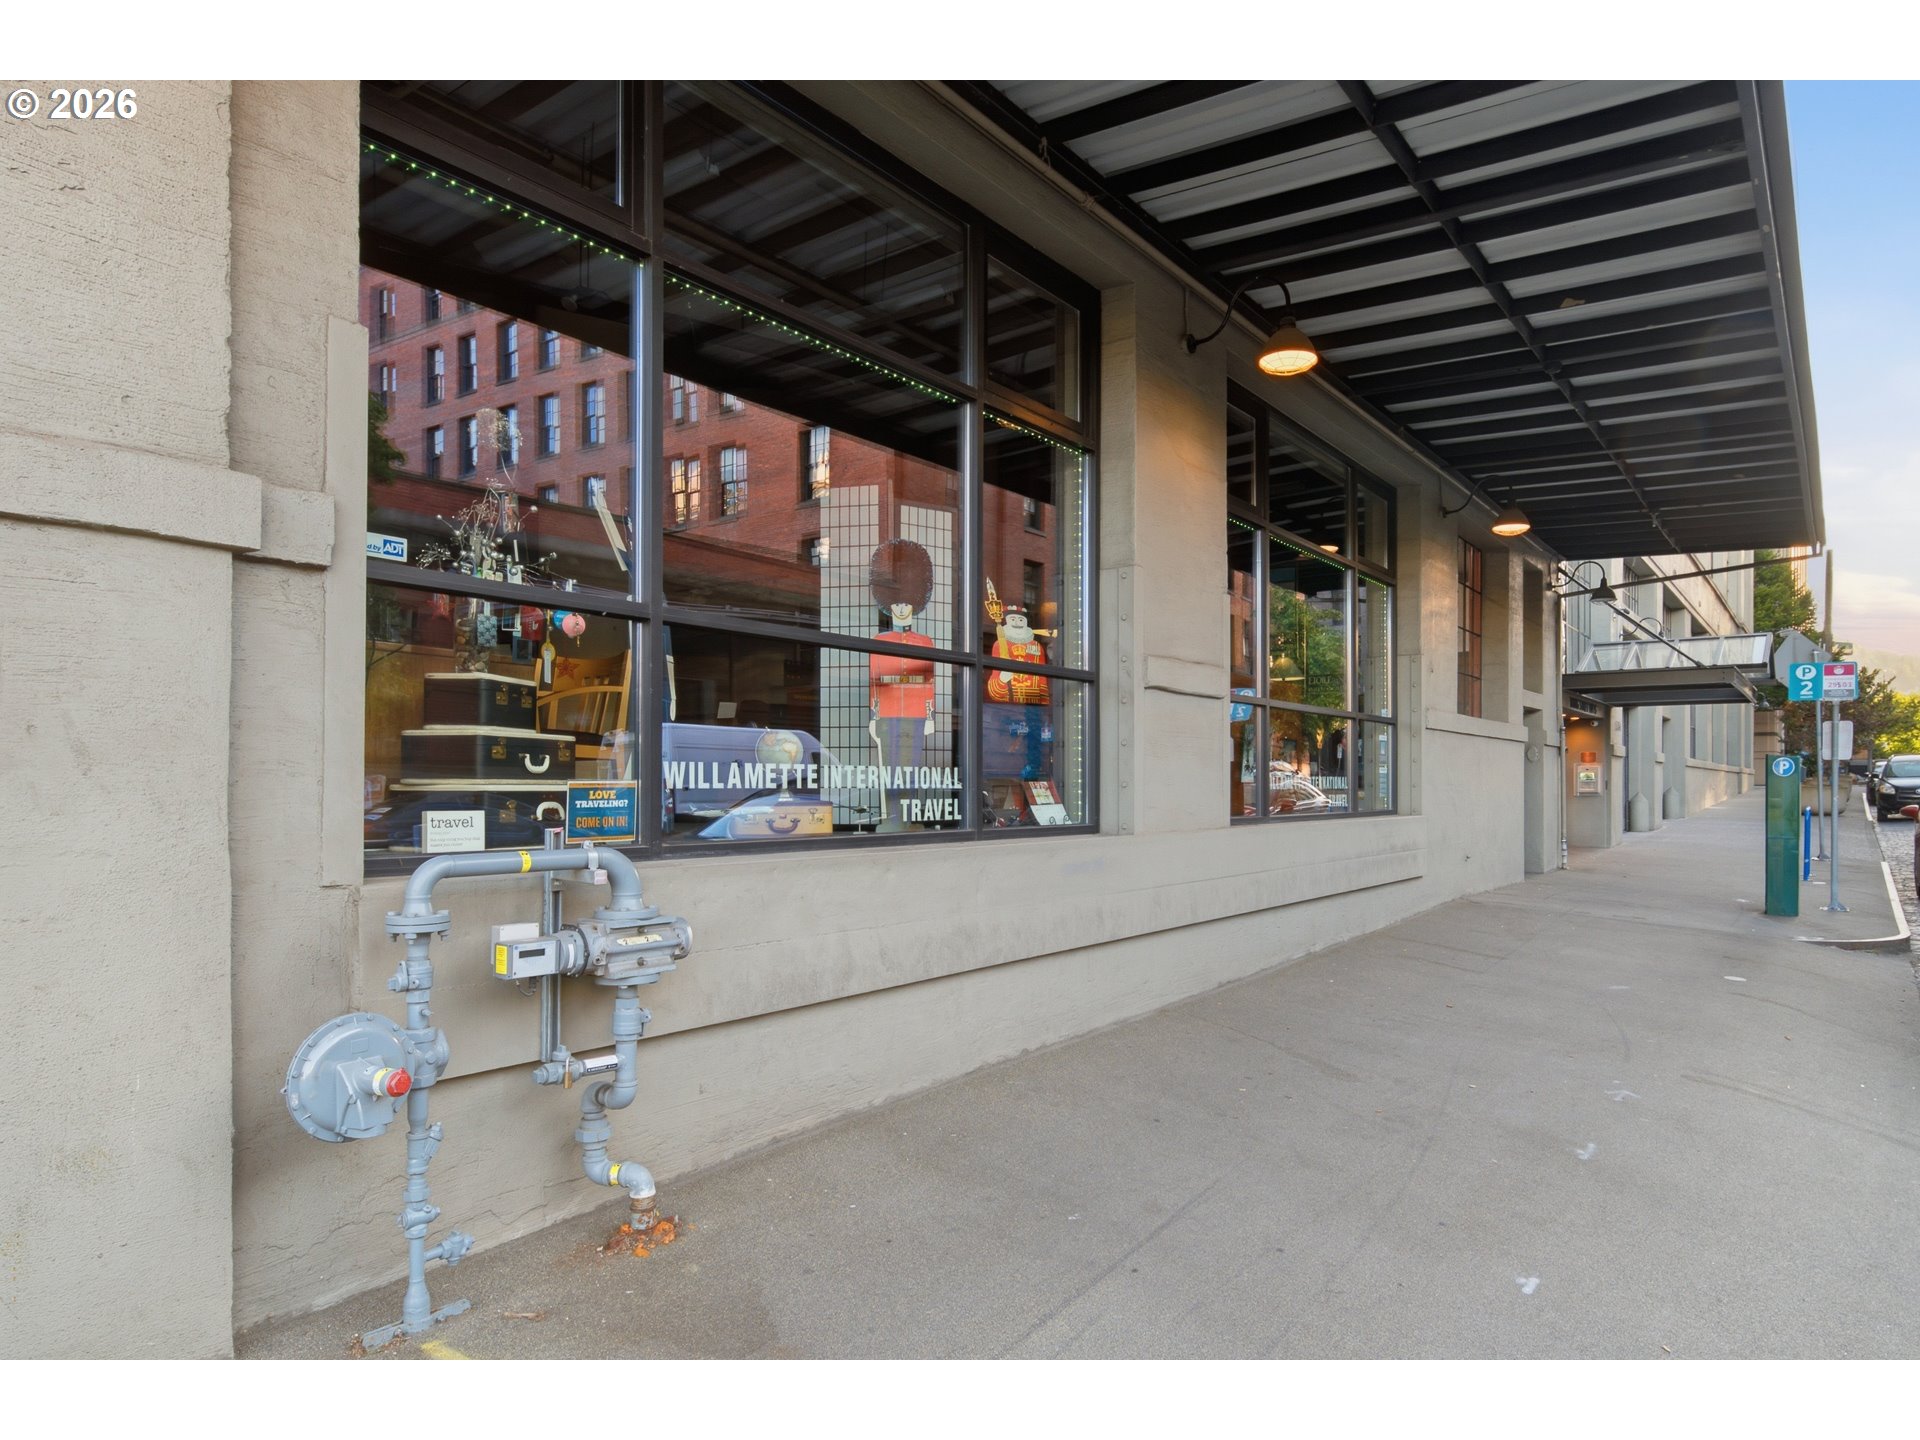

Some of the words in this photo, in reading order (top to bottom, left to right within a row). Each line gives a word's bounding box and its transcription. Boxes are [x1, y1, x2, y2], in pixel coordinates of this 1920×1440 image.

[384, 542, 404, 555] ADT
[1802, 667, 1812, 678] P
[1800, 681, 1813, 695] 2
[662, 761, 818, 789] WILLAMETTE
[823, 765, 962, 789] INTERNATIONAL
[589, 790, 617, 799] LOVE
[575, 799, 629, 809] TRAVELING?
[900, 798, 962, 822] TRAVEL
[430, 816, 474, 829] travel
[576, 816, 600, 829] COME
[603, 816, 614, 828] ON
[616, 815, 628, 828] IN!
